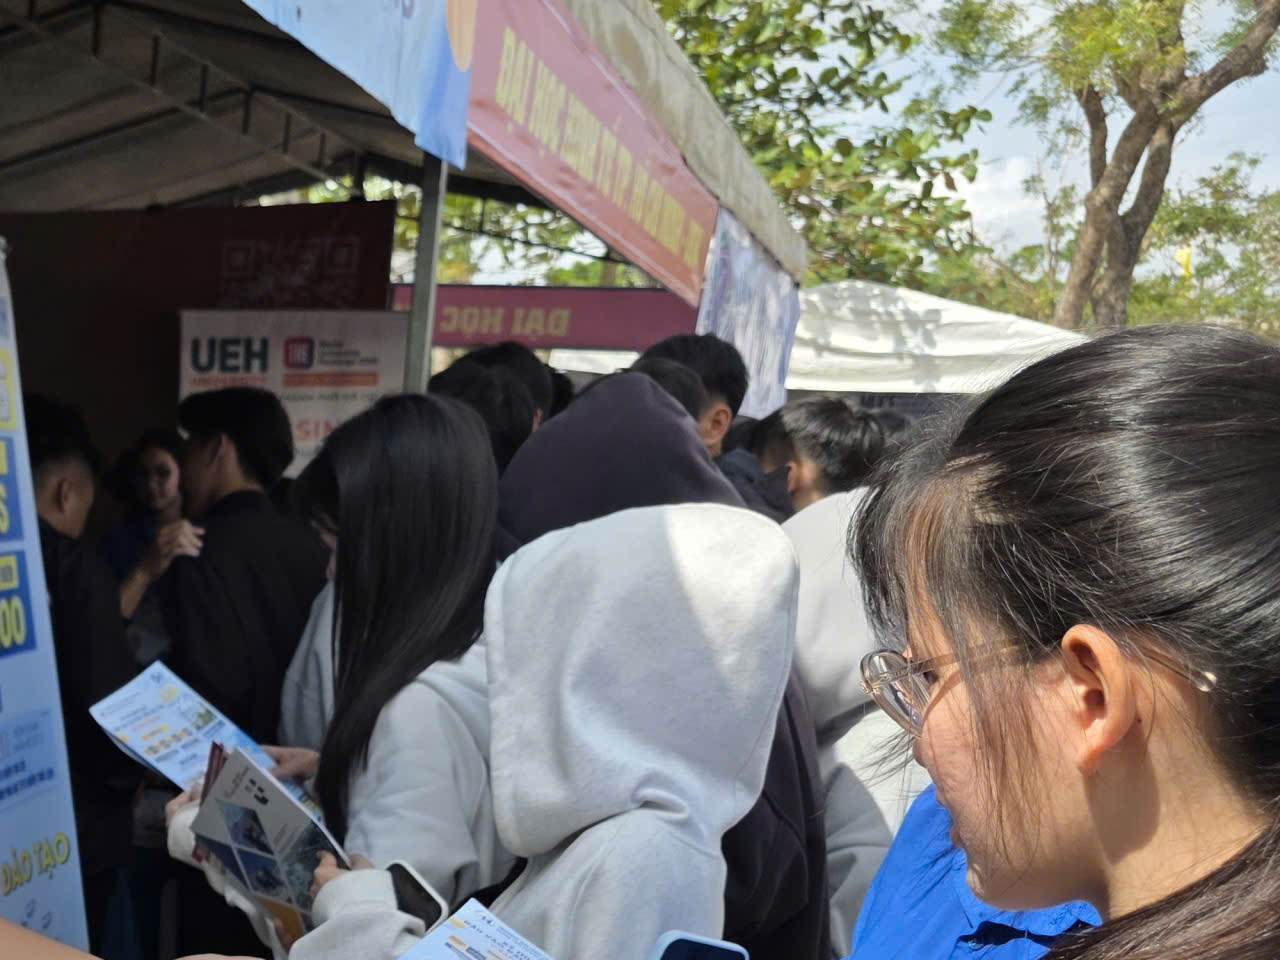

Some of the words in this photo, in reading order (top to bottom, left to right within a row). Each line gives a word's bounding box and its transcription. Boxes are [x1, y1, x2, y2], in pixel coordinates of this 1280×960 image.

[191, 336, 268, 373] UEH
[1, 847, 33, 896] ĐÀO
[34, 831, 70, 880] TẠO
